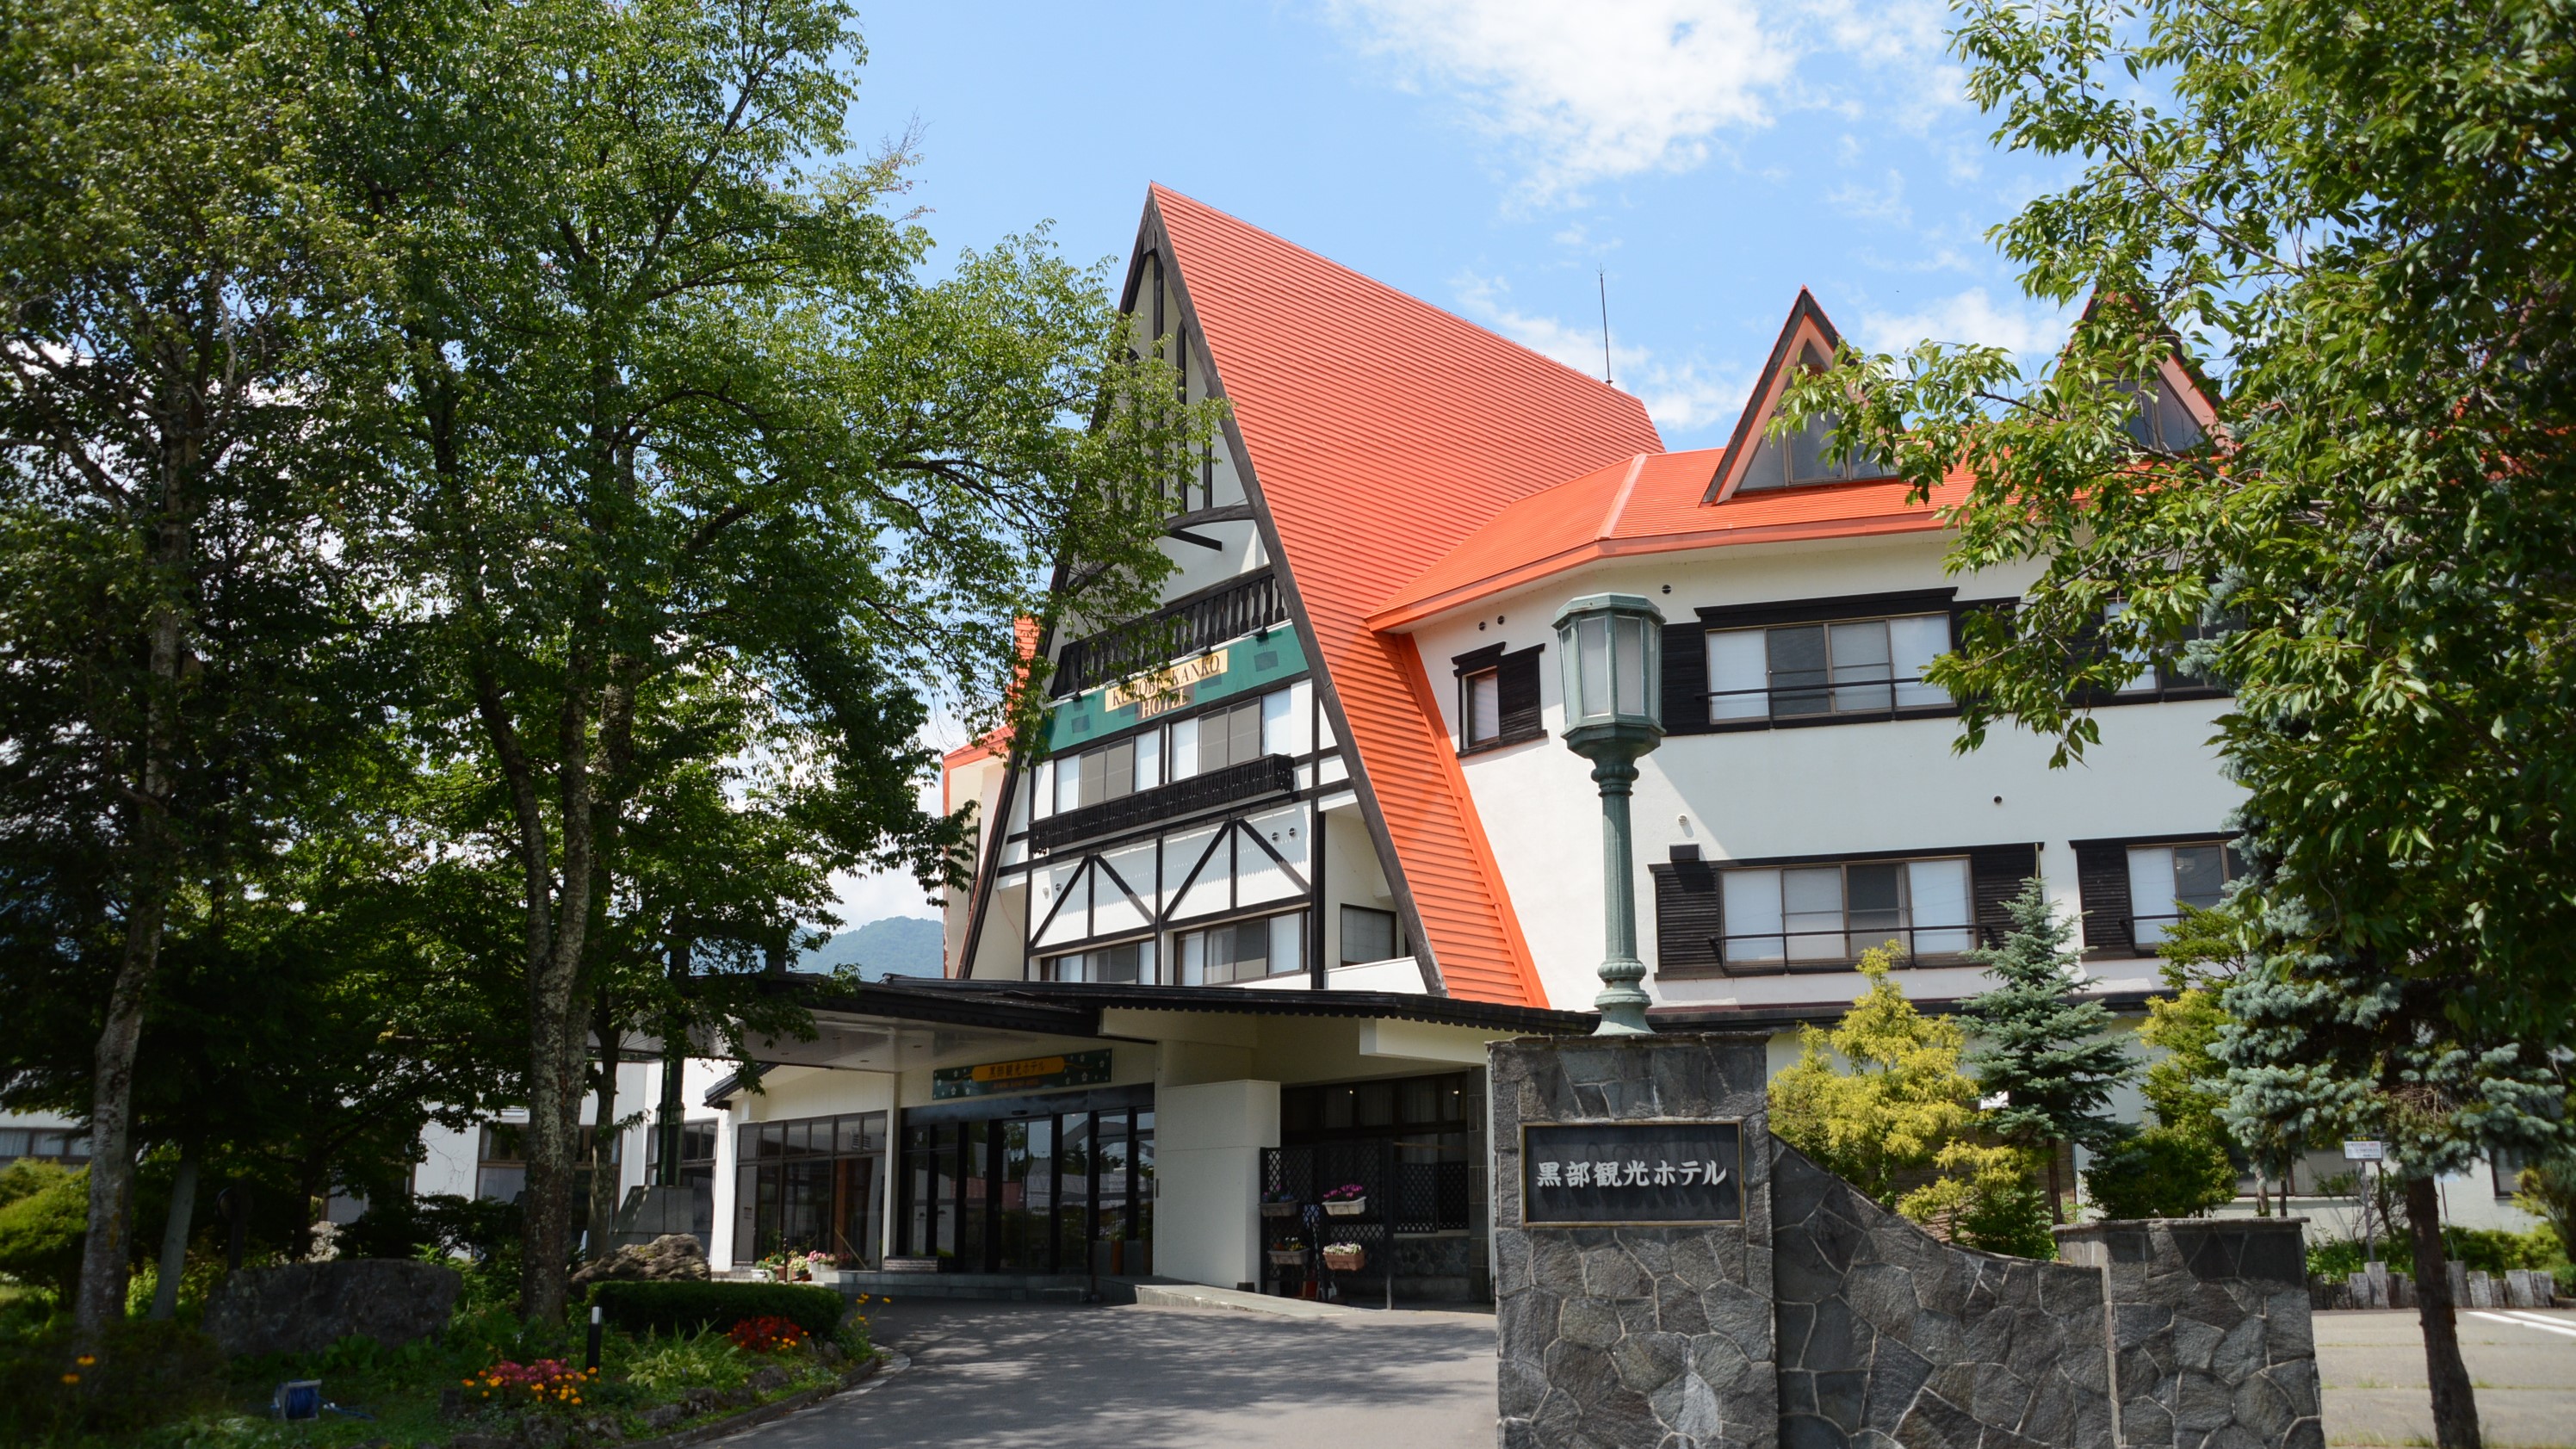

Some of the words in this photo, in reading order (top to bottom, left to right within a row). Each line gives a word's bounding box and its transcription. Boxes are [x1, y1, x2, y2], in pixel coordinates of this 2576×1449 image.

[1171, 654, 1220, 685] KANKO
[1142, 688, 1188, 719] HOTEL
[1537, 1160, 1726, 1187] 黒部観光ホテル
